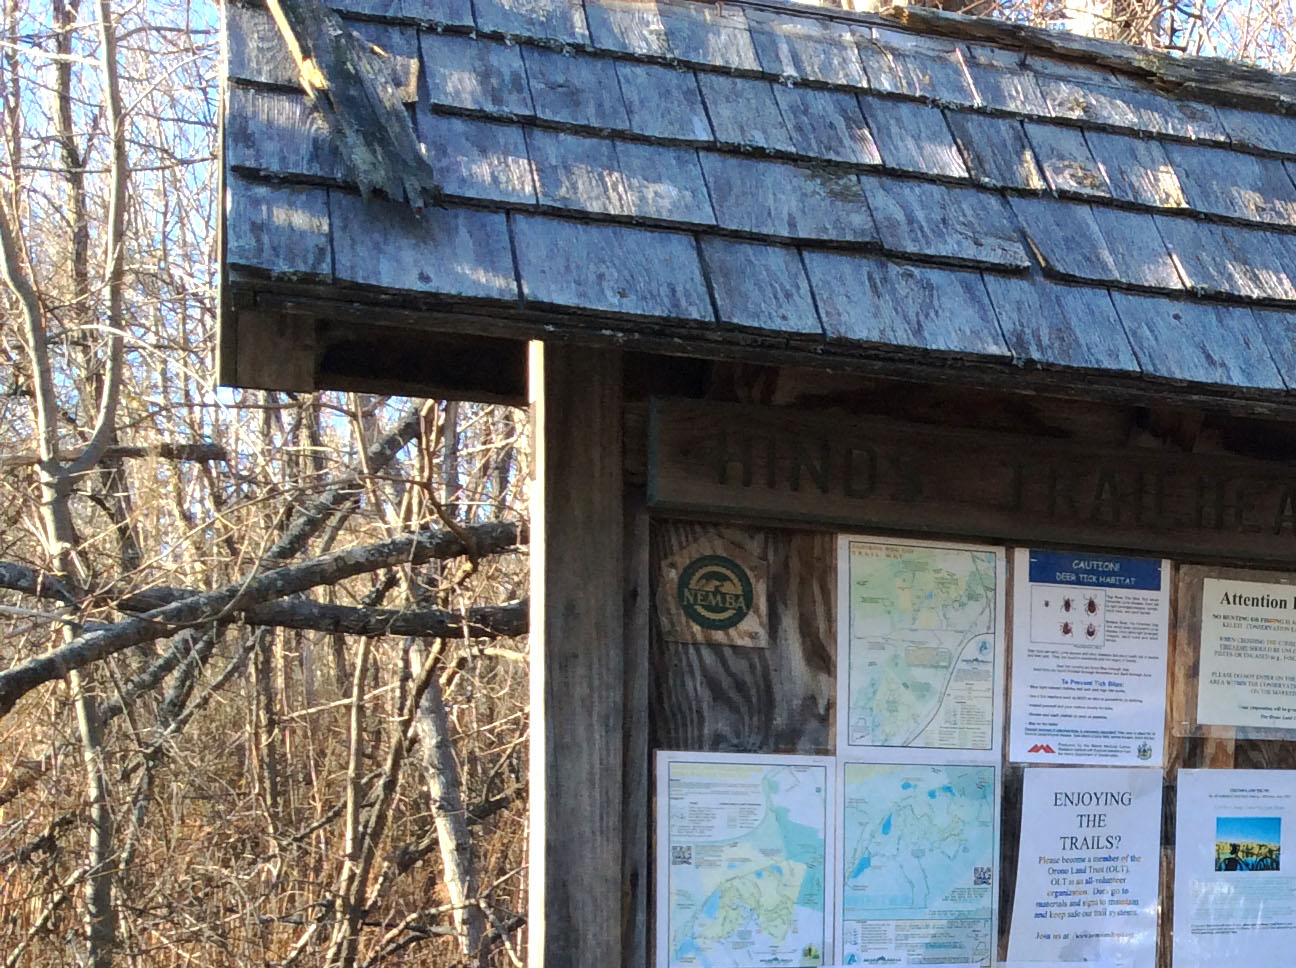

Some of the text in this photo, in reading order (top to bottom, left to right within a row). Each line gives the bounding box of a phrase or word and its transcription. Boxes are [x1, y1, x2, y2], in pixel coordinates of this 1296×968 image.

[1072, 559, 1120, 572] CAUTION!
[1056, 572, 1137, 585] DEER TICK HABITAT
[683, 588, 748, 612] NEMBA
[1220, 591, 1288, 610] Attention
[1223, 614, 1249, 622] HUNTING
[1053, 791, 1132, 806] ENJOYING
[1076, 813, 1107, 829] THE
[1060, 835, 1122, 851] TRAILS?
[1038, 856, 1060, 865] Please
[1061, 856, 1086, 864] become
[1092, 854, 1119, 863] member
[1121, 854, 1129, 863] of
[1130, 854, 1141, 862] the
[1047, 866, 1069, 875] Orono
[1070, 865, 1087, 875] Land
[1088, 865, 1105, 874] Trust
[1050, 877, 1068, 886] OLT
[1110, 889, 1121, 897] go
[1035, 899, 1068, 908] materials
[1068, 899, 1082, 907] and
[1108, 898, 1139, 906] maintain
[1033, 911, 1048, 919] and
[1049, 910, 1066, 921] keep
[1066, 909, 1081, 918] safe
[1081, 910, 1093, 918] our
[1093, 908, 1108, 917] trail
[1035, 931, 1051, 940] Join
[1063, 932, 1070, 940] at
